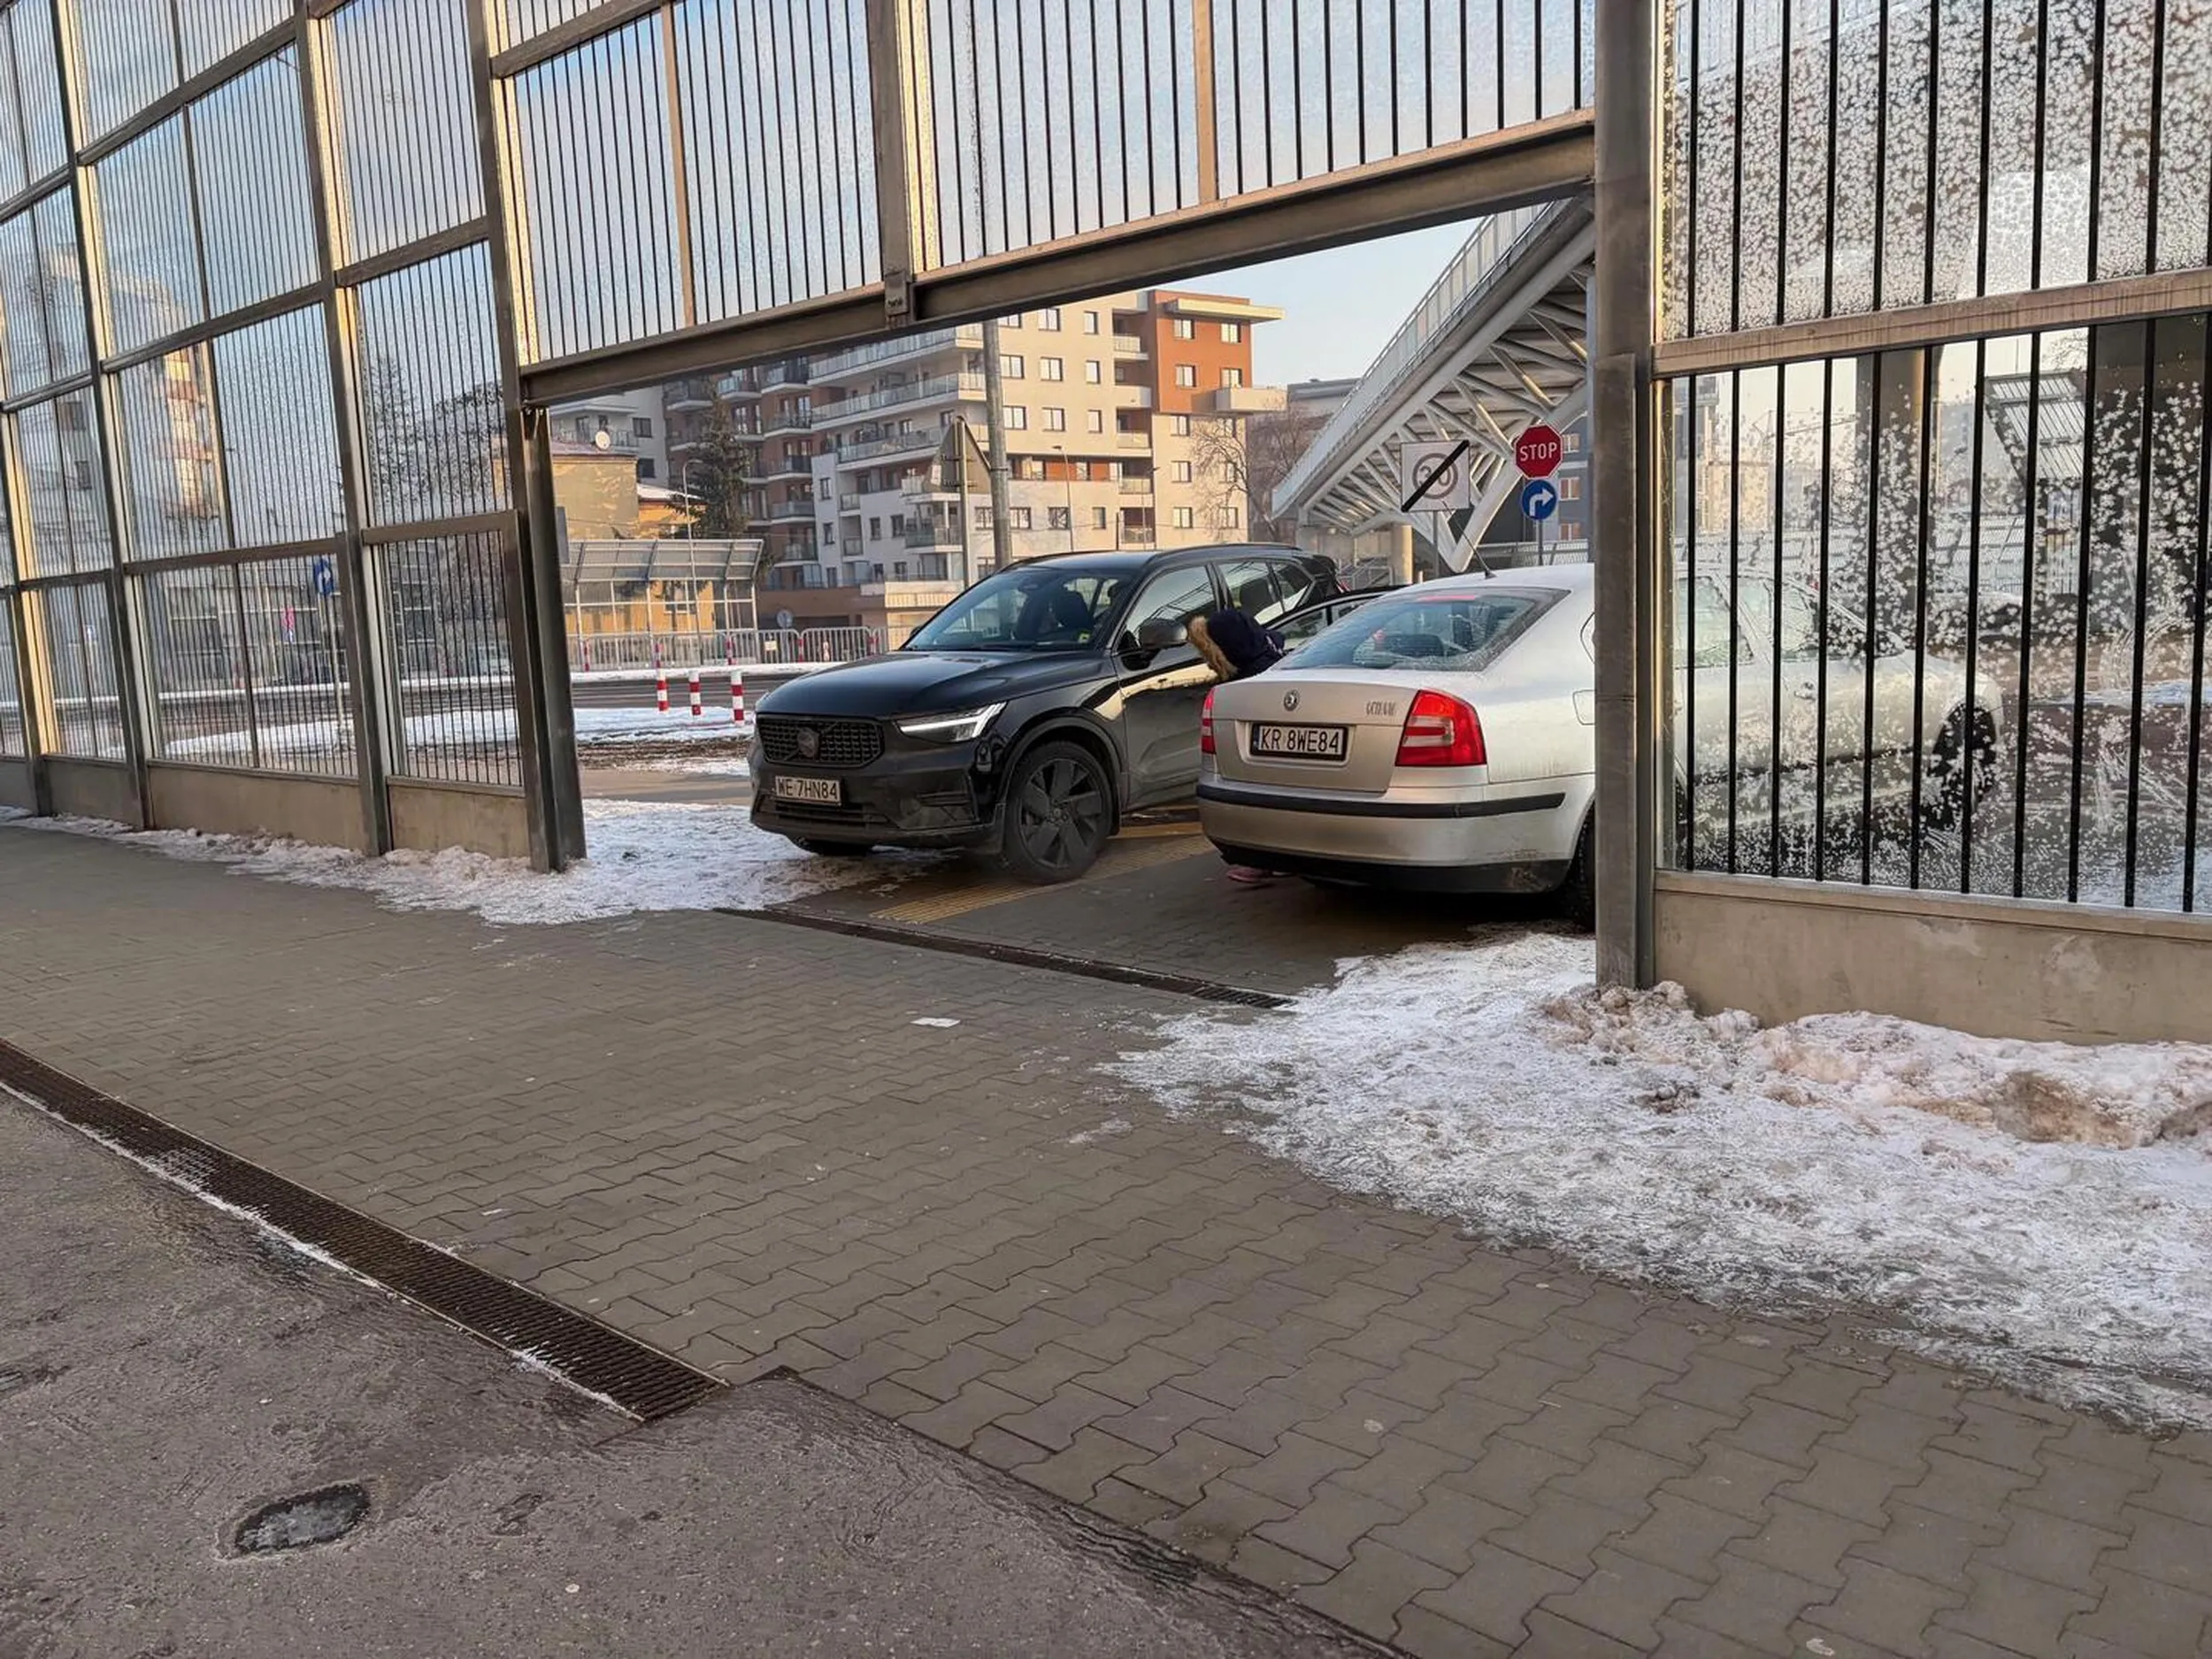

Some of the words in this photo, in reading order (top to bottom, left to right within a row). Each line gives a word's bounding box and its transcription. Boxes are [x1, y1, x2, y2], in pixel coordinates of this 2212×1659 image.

[1519, 442, 1557, 461] STOP
[1261, 727, 1282, 750] KR
[1286, 729, 1340, 753] 8WE84
[777, 778, 794, 796] WE
[796, 780, 838, 800] 7HN84
